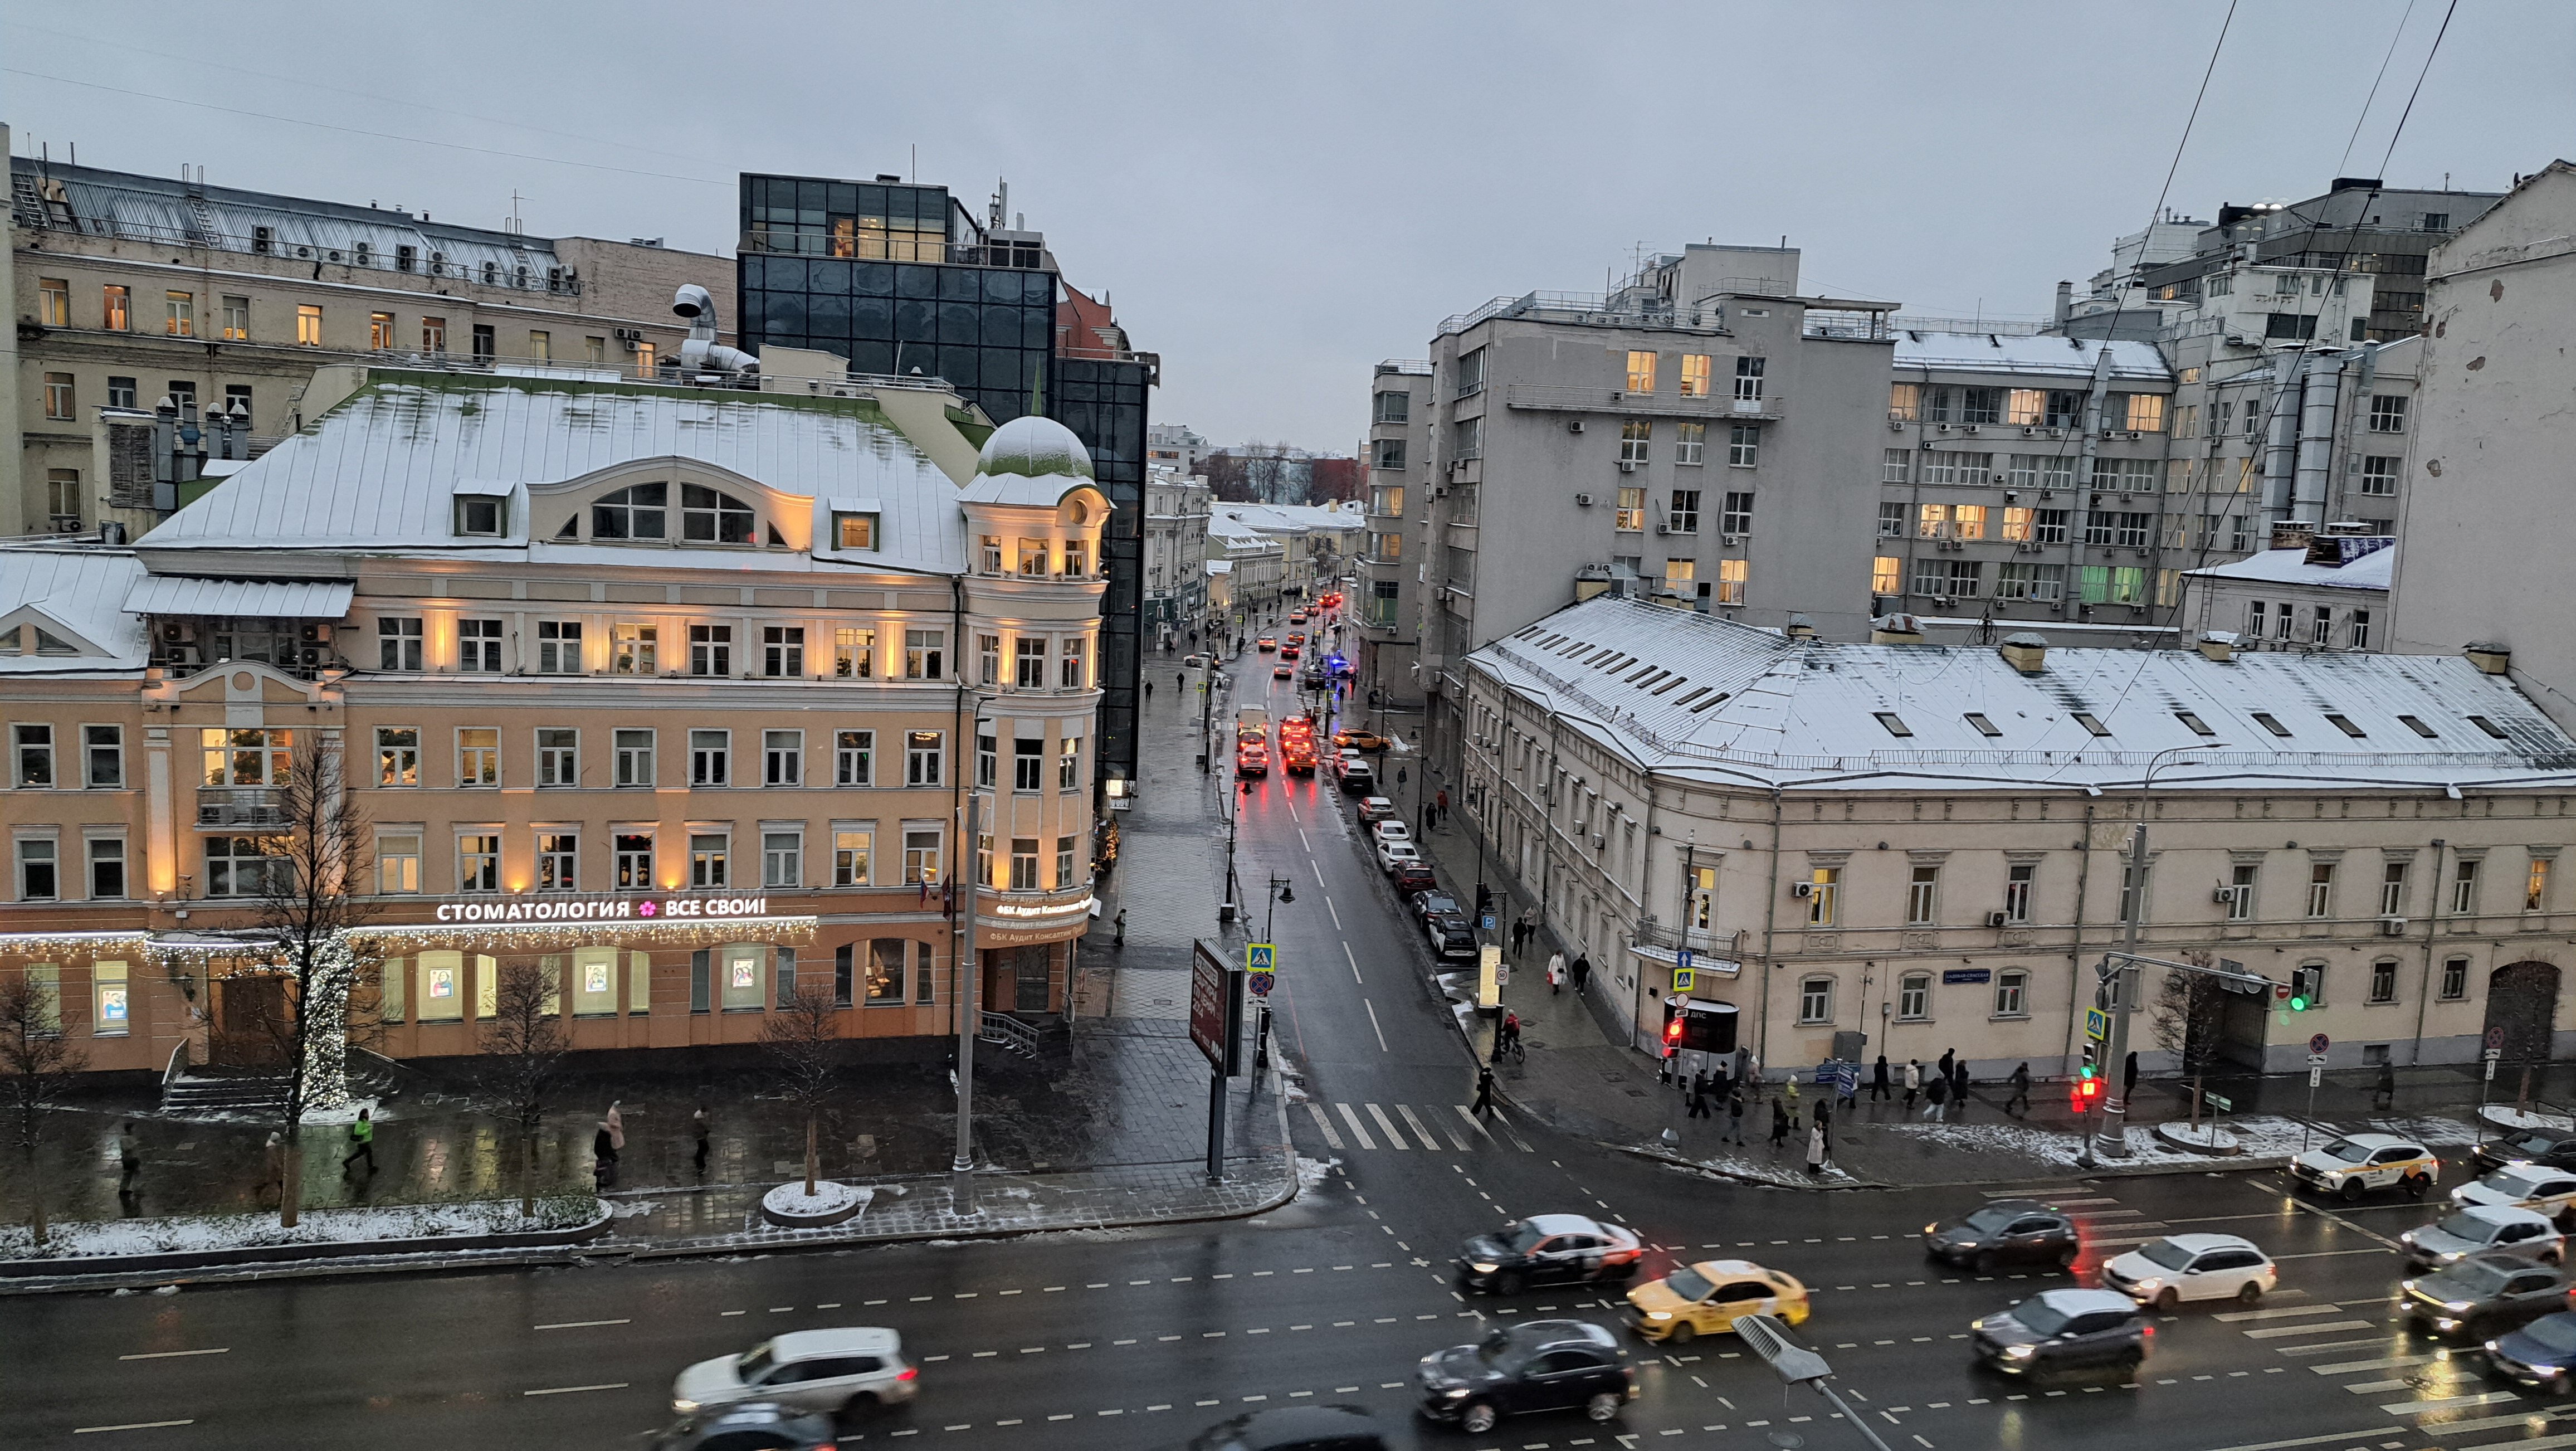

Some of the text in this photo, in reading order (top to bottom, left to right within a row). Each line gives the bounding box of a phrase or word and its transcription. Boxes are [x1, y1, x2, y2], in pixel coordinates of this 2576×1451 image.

[437, 898, 766, 920] СТОМАТОЛОГИЯ ВСЕ СВОИ!
[997, 905, 1015, 914] ФБК
[1016, 905, 1041, 917] Аудит
[1486, 917, 1493, 928] P
